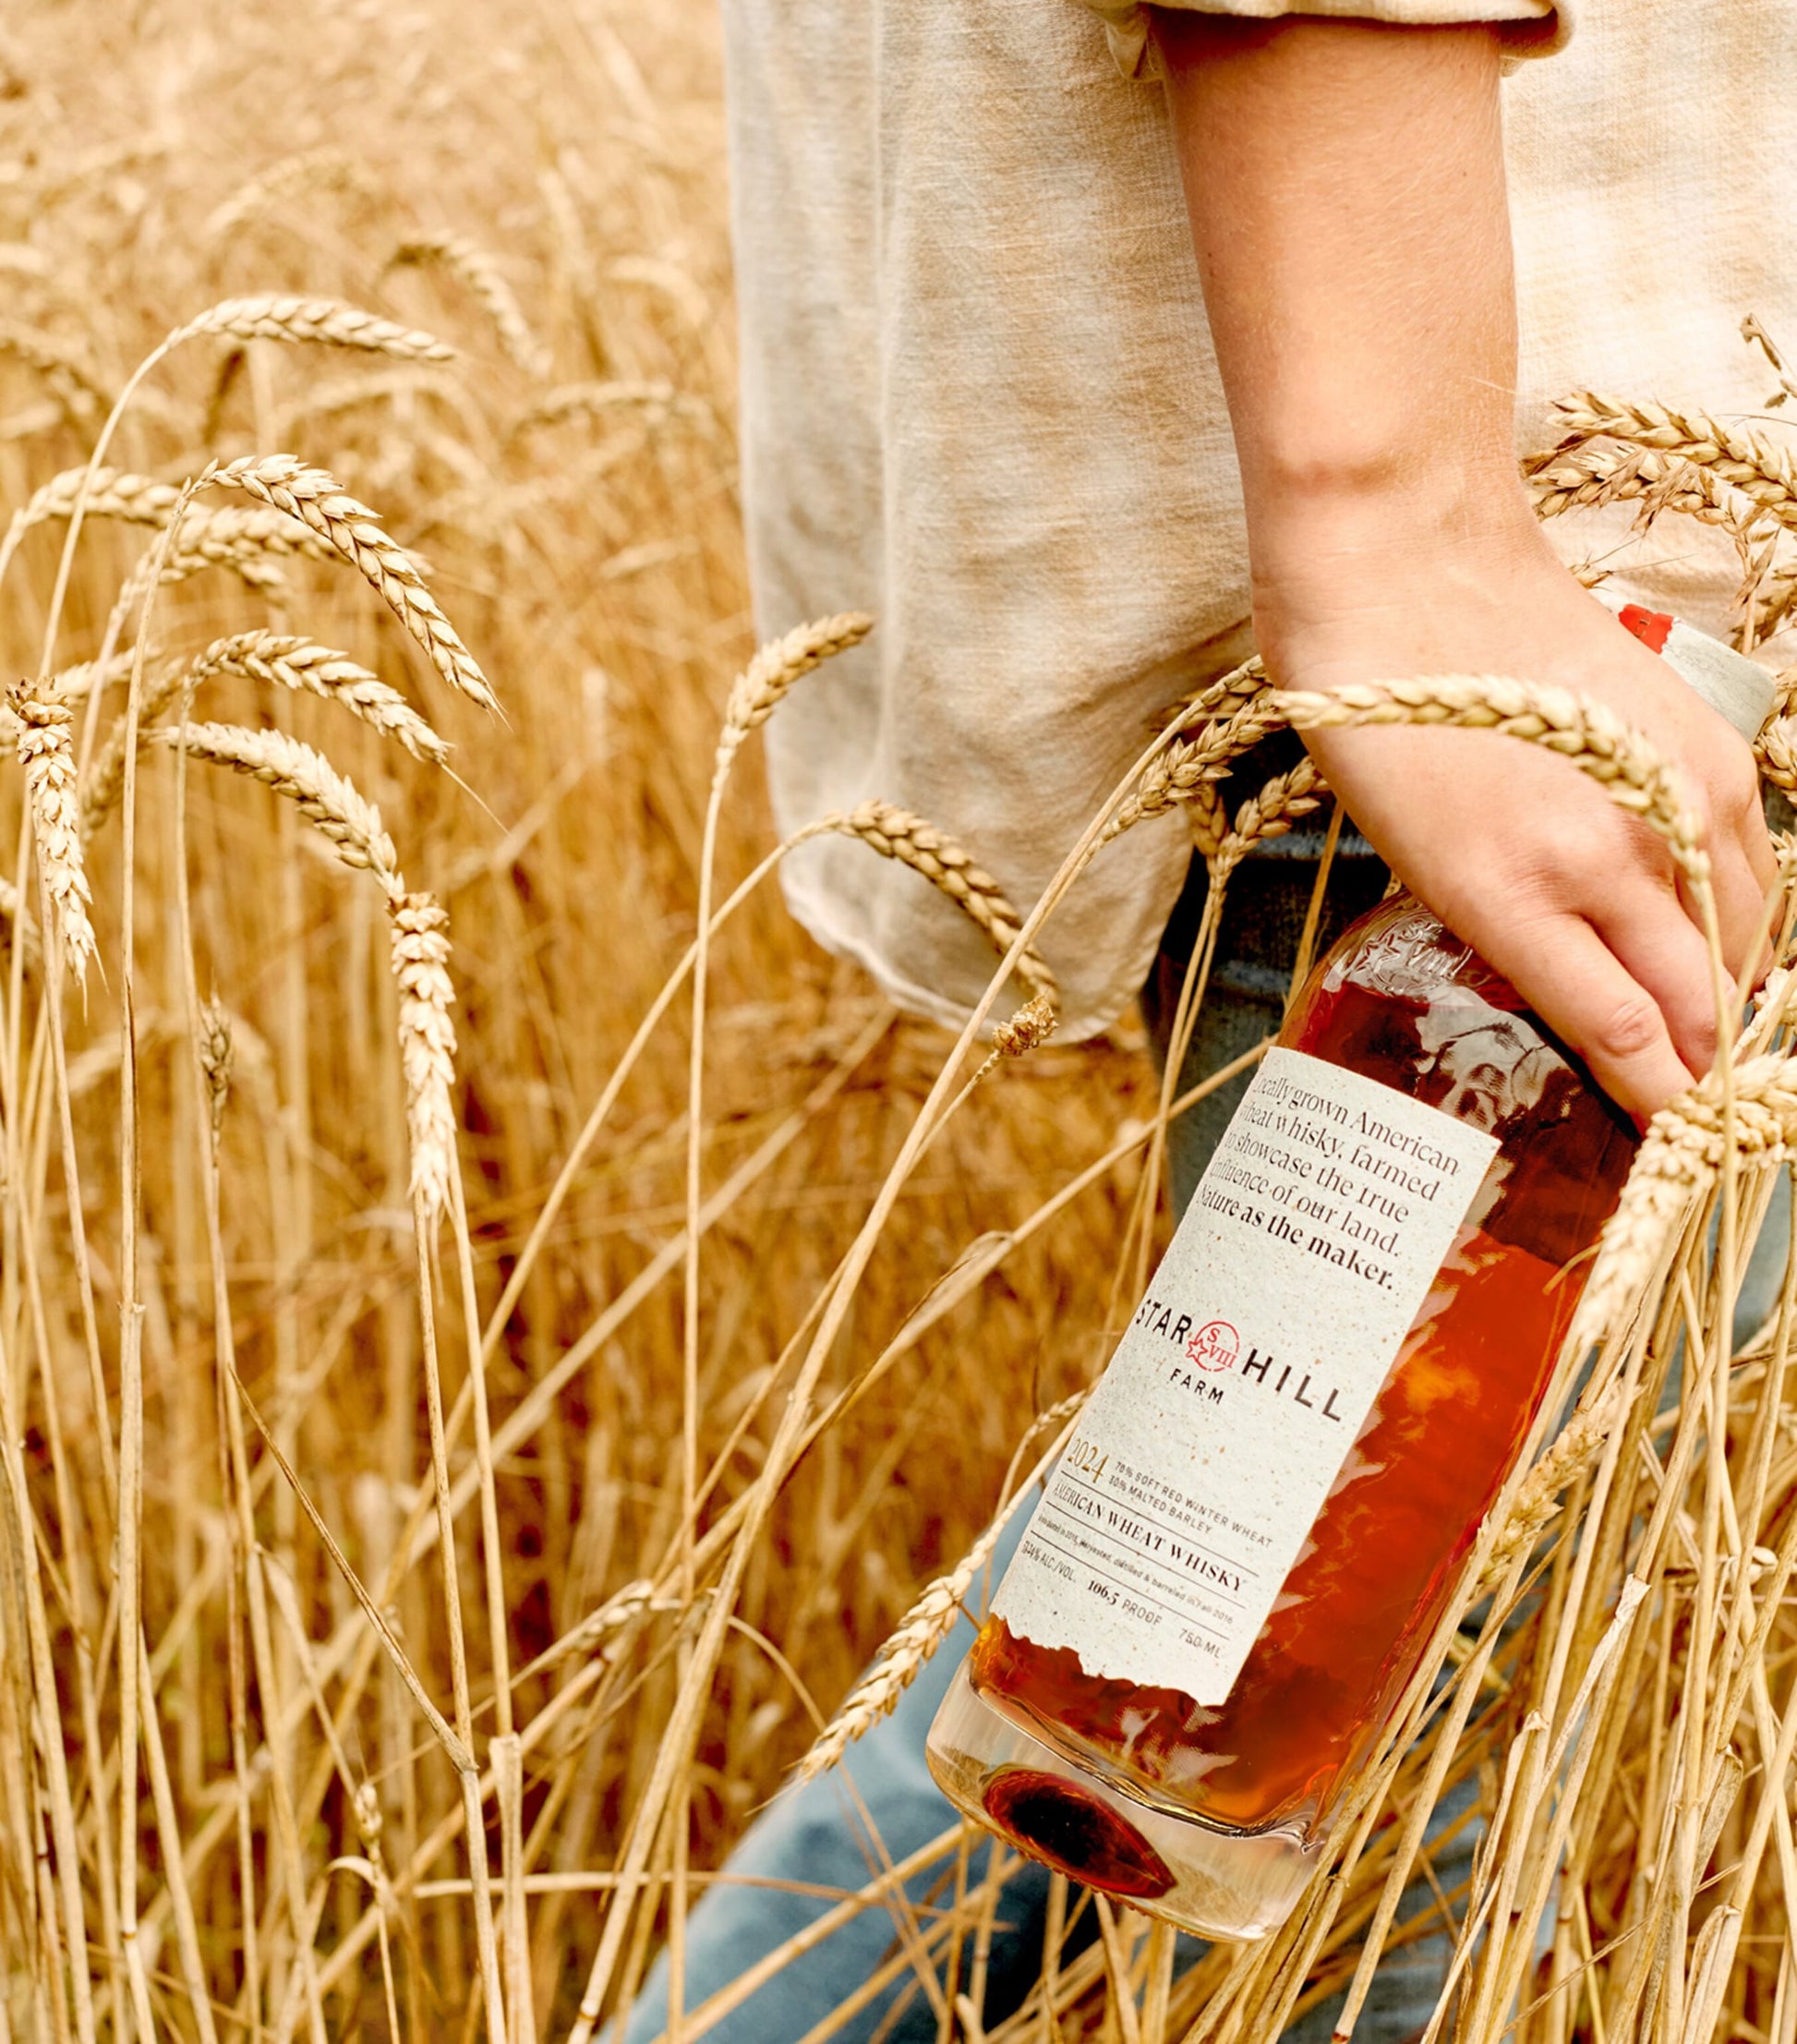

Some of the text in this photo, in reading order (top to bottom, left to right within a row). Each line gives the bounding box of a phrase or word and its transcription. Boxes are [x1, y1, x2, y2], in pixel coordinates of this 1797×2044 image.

[1275, 1114, 1345, 1160] whisky,
[1349, 1143, 1441, 1203] farmed
[1287, 1089, 1349, 1126] grown
[1348, 1110, 1459, 1178] American
[1234, 1132, 1313, 1179] showcase
[1315, 1167, 1354, 1197] the
[1355, 1186, 1410, 1224] true
[1271, 1184, 1299, 1205] of
[1294, 1196, 1339, 1225] our
[1339, 1210, 1402, 1258] land.
[1195, 1184, 1393, 1291] Nature as the maker.
[1135, 1298, 1342, 1423] STAR HILL
[1169, 1367, 1224, 1406] FARM
[1066, 1437, 1110, 1484] 2024
[1115, 1460, 1273, 1548] 70% SOFT RED WINTER WHEAT
[1054, 1482, 1106, 1520] AMERICAN
[1107, 1510, 1167, 1552] WHEAT
[1170, 1543, 1248, 1592] WHISKY
[1128, 1485, 1167, 1512] MALTED
[1168, 1506, 1212, 1534] BARLEY
[1086, 1579, 1163, 1626] 106.5 PROOF
[1178, 1627, 1221, 1660] 750 ML
